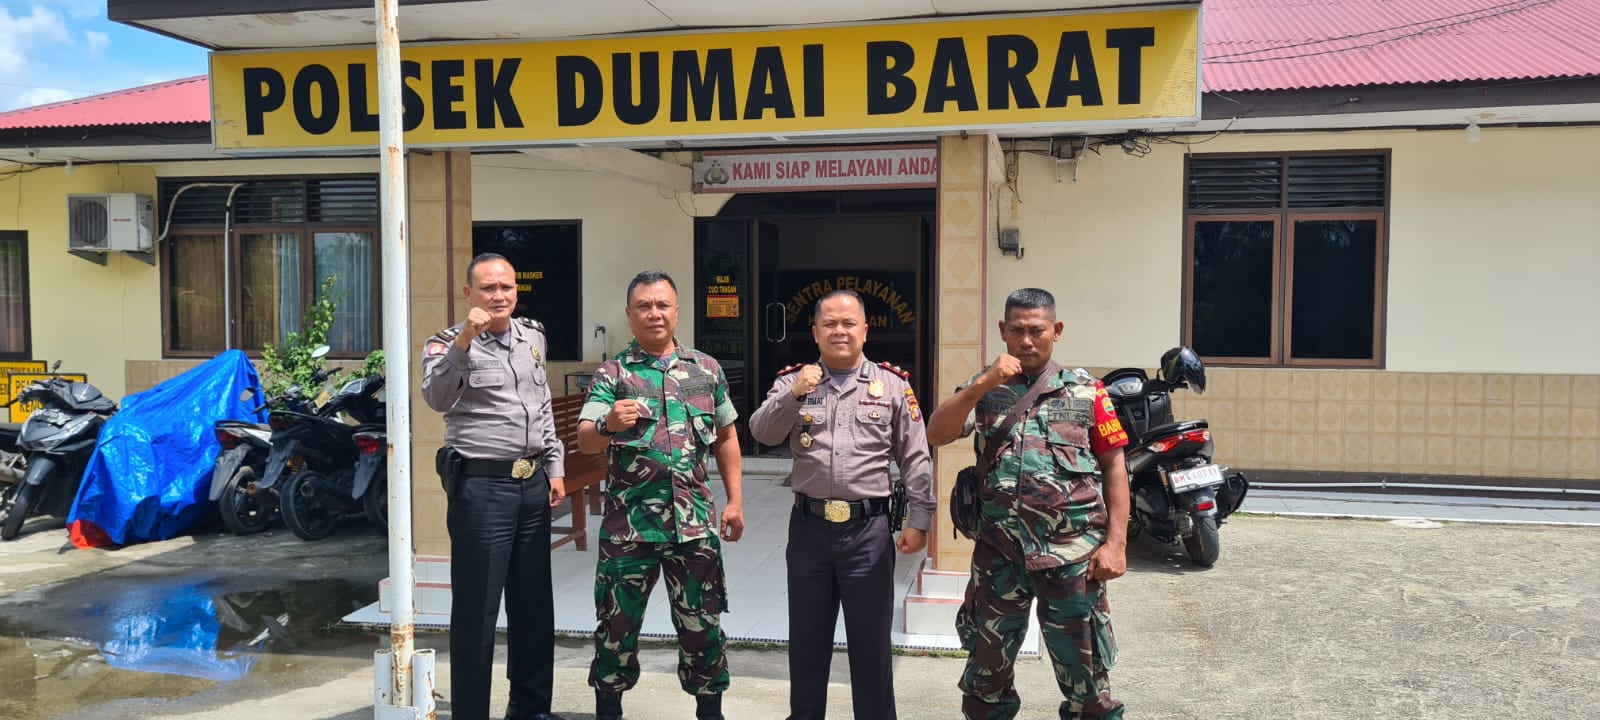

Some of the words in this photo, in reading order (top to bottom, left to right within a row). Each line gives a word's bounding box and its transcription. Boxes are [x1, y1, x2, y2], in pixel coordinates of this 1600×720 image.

[244, 57, 524, 136] POLSEK
[556, 43, 825, 127] DUMAI
[866, 26, 1155, 117] BARAT
[733, 161, 771, 180] KAMI
[776, 160, 810, 179] SIAP
[815, 157, 893, 178] MELAYANI
[897, 155, 938, 175] ANDA
[785, 279, 833, 323] SENTRA
[836, 276, 914, 325] PELAYANAN
